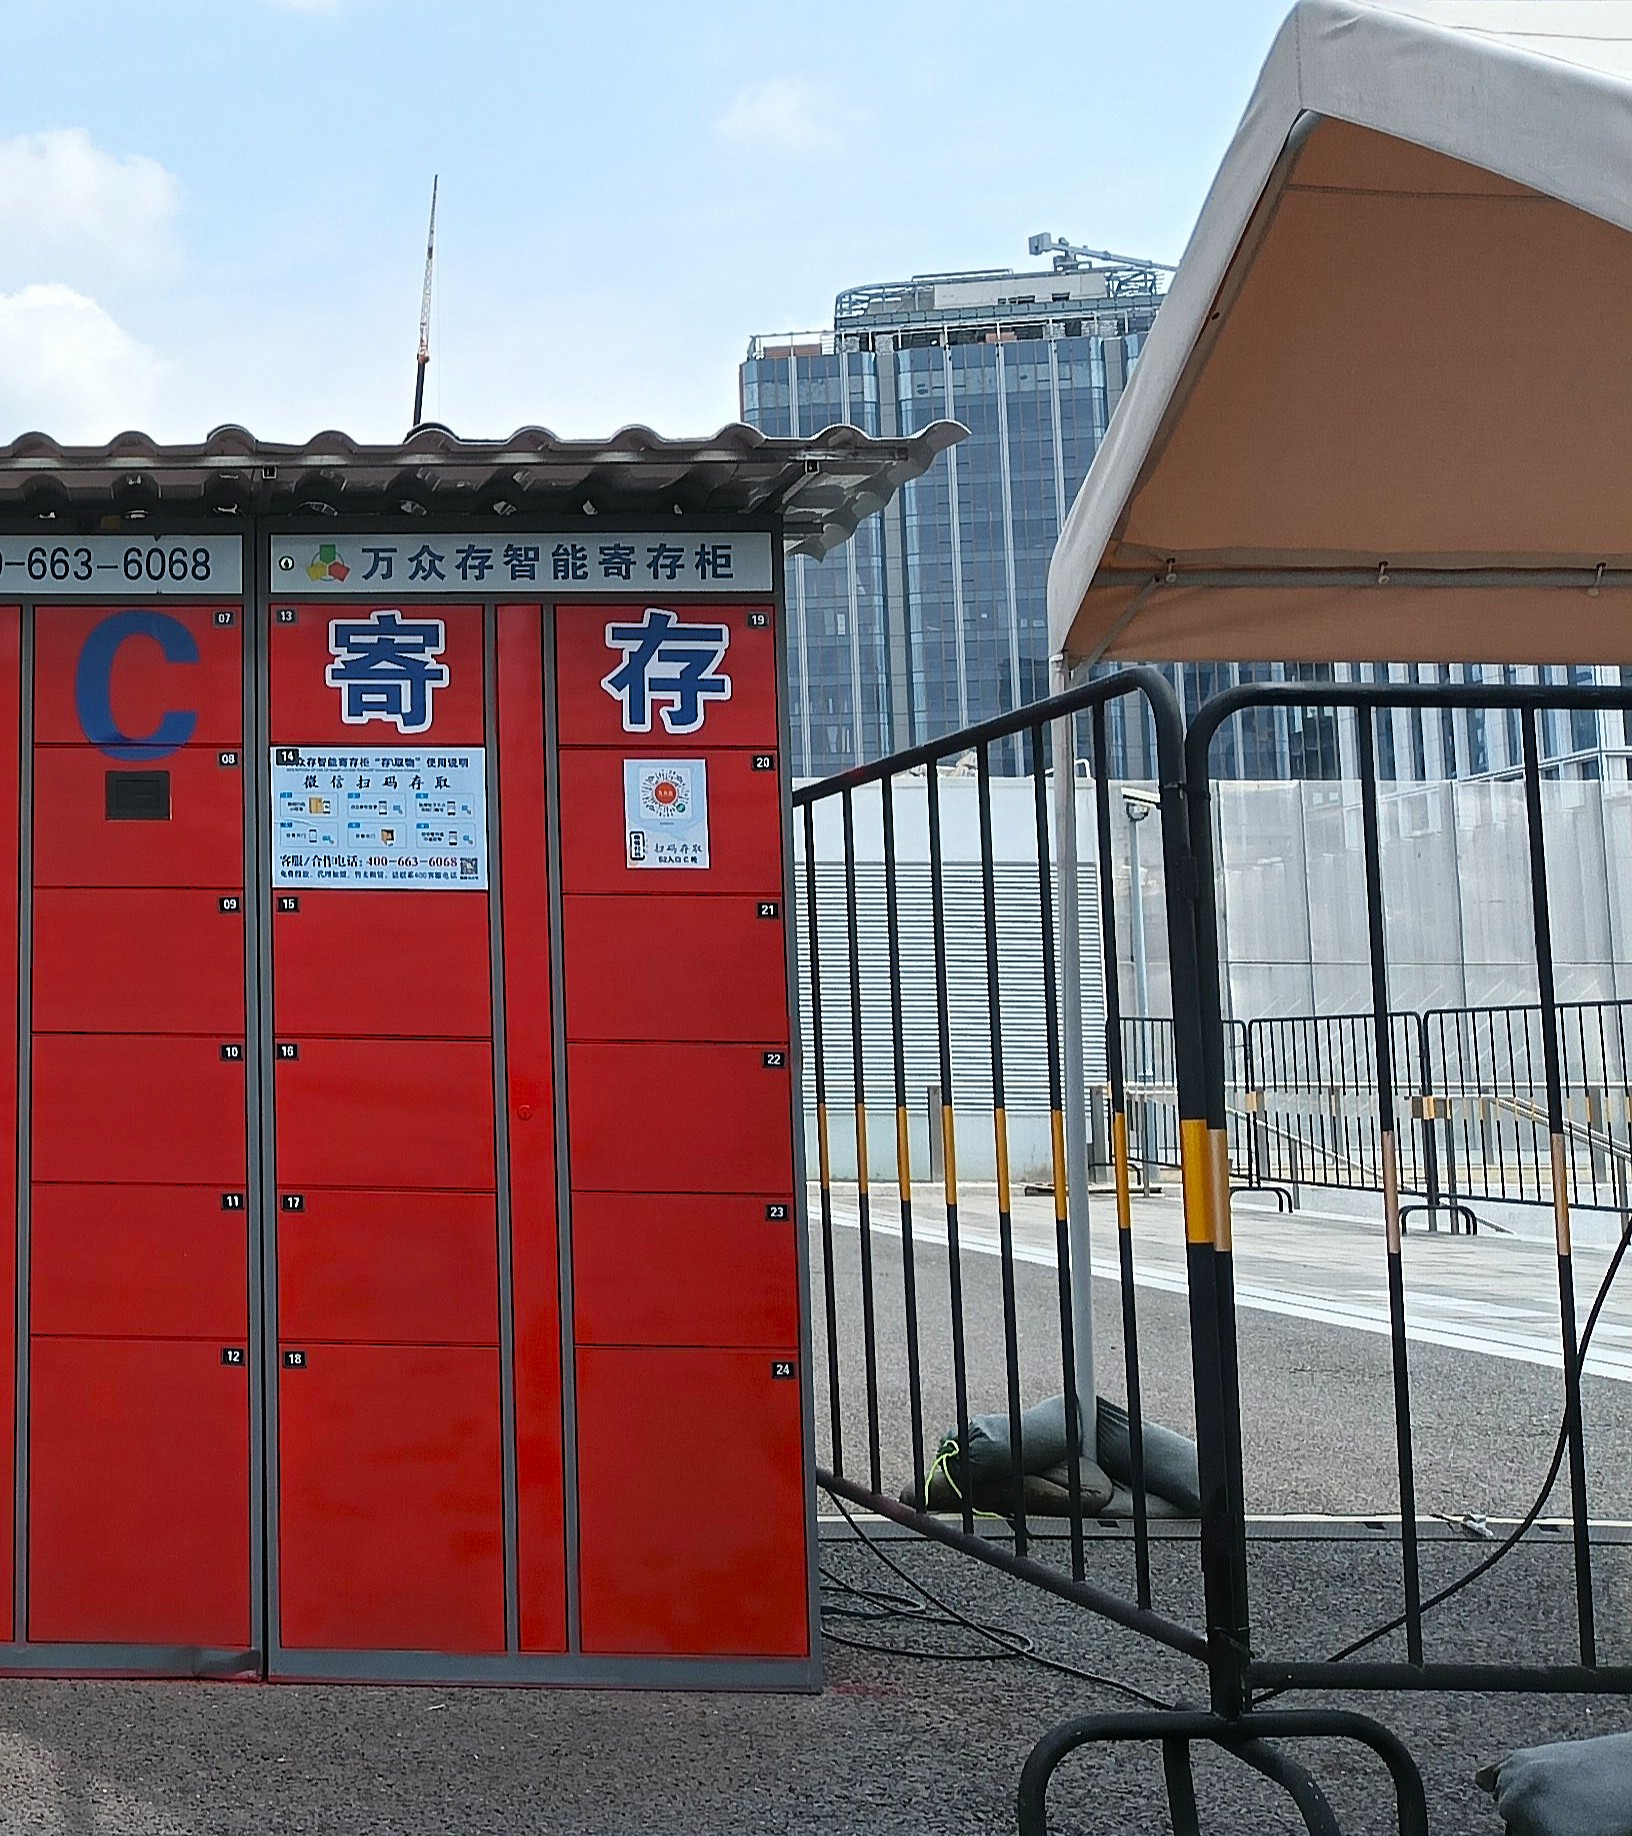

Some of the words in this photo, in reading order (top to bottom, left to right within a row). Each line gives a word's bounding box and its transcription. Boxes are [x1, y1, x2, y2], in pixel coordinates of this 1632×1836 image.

[361, 543, 735, 581] 万众存智能寄存柜
[218, 613, 231, 623] 07
[280, 610, 293, 621] 13
[751, 614, 765, 625] 19
[75, 610, 199, 762] C
[221, 753, 236, 764] 08
[281, 750, 294, 762] 14
[756, 756, 770, 768] 20
[303, 775, 451, 790] 微信扫码存取
[654, 842, 703, 854] 扫码存取
[223, 898, 237, 910] 09
[282, 898, 295, 909] 15
[761, 904, 774, 916] 21
[225, 1046, 239, 1058] 10
[281, 1045, 294, 1057] 16
[767, 1053, 781, 1065] 22
[226, 1195, 239, 1207] 11
[287, 1196, 300, 1208] 17
[770, 1206, 784, 1218] 23
[227, 1350, 240, 1362] 12
[288, 1353, 302, 1364] 18
[776, 1363, 790, 1375] 24
